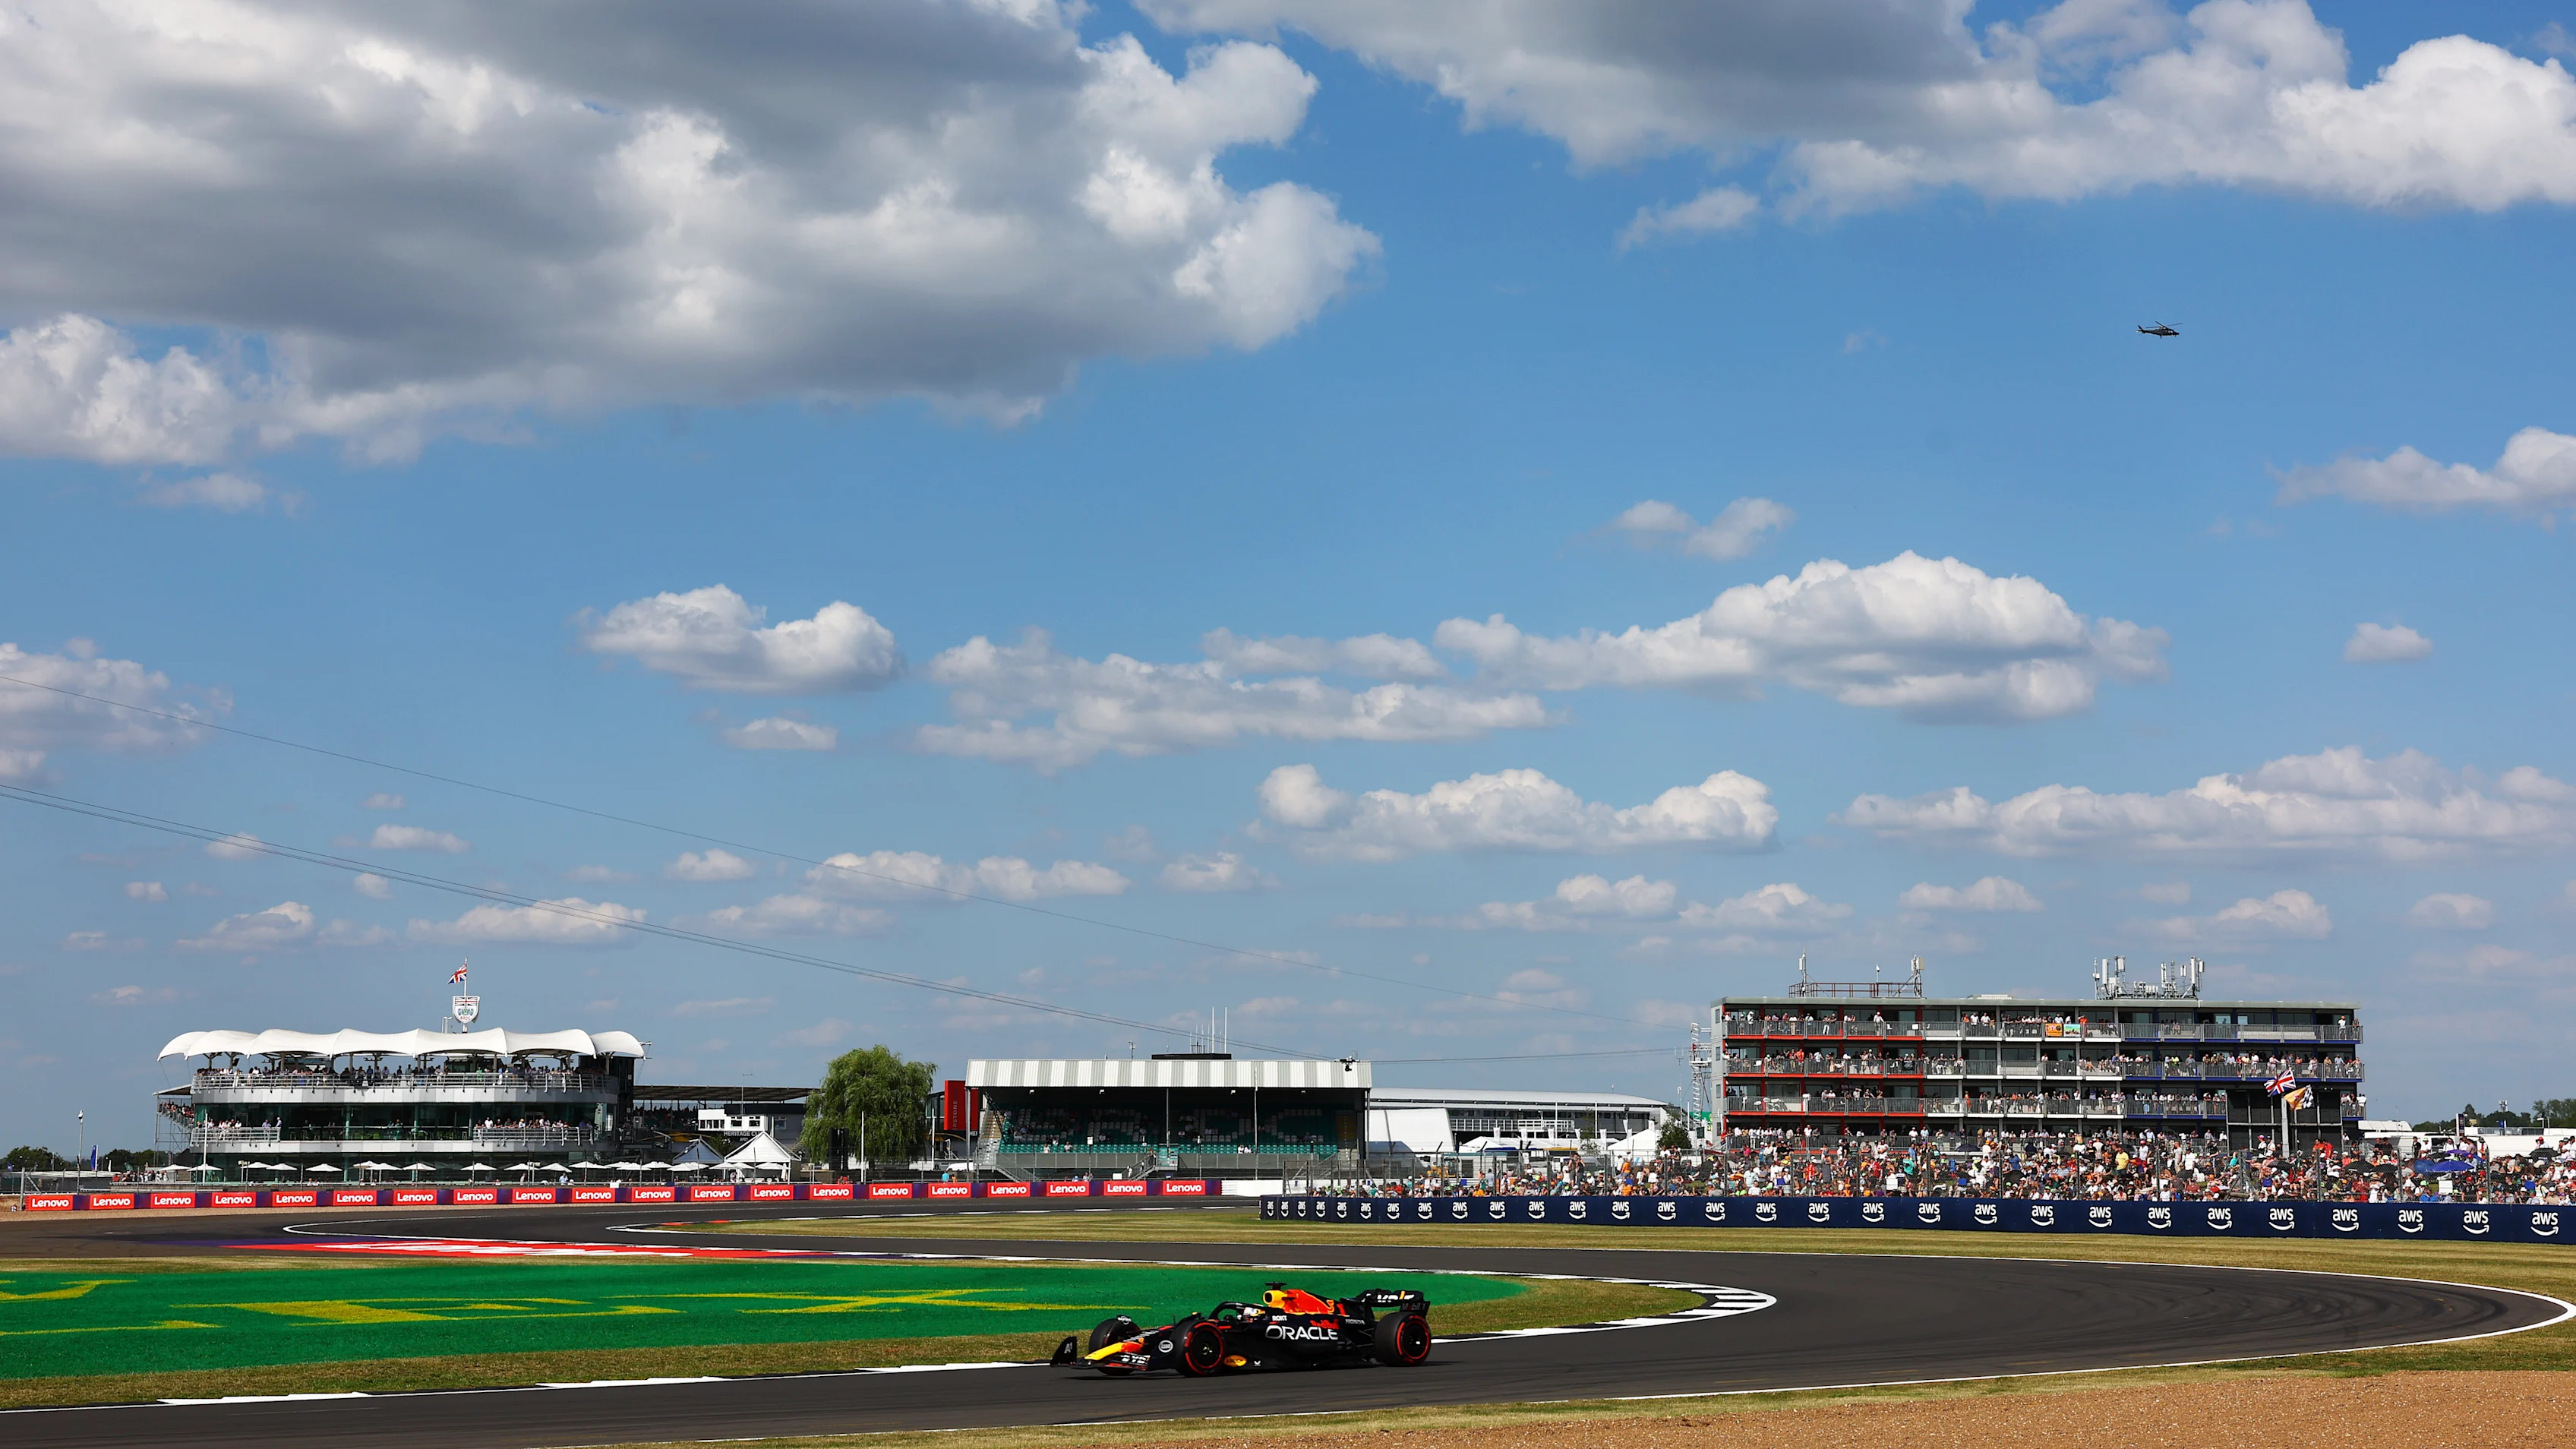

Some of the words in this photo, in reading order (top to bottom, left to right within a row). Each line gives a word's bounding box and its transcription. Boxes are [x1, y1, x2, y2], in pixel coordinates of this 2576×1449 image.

[754, 1189, 790, 1197] Lenovo
[814, 1188, 849, 1196] Lenovo
[873, 1187, 908, 1195] Lenovo
[932, 1186, 968, 1195] Lenovo
[991, 1185, 1027, 1194] Lenovo
[1050, 1185, 1086, 1193] Lenovo
[1107, 1184, 1143, 1192] Lenovo
[337, 1194, 373, 1202] Lenovo
[397, 1193, 433, 1201] Lenovo
[457, 1192, 493, 1201] Lenovo
[516, 1192, 552, 1200] Lenovo
[695, 1189, 731, 1198] Lenovo
[93, 1198, 131, 1206] Lenovo
[216, 1195, 252, 1204] Lenovo
[276, 1195, 313, 1203] Lenovo
[1337, 1202, 1346, 1211] aws
[1361, 1203, 1371, 1211] aws
[1387, 1203, 1399, 1212] aws
[1419, 1202, 1432, 1212] aws
[1453, 1202, 1467, 1211] aws
[1490, 1201, 1504, 1211] aws
[1529, 1201, 1545, 1211] aws
[1570, 1201, 1586, 1211] aws
[1612, 1201, 1629, 1211] aws
[1658, 1202, 1675, 1212] aws
[1706, 1202, 1725, 1213] aws
[1756, 1203, 1776, 1213] aws
[1809, 1203, 1829, 1214] aws
[1863, 1203, 1883, 1214] aws
[1918, 1204, 1940, 1214] aws
[1975, 1204, 1996, 1215] aws
[2031, 1205, 2053, 1217] aws
[2089, 1207, 2111, 1218] aws
[2148, 1208, 2170, 1219] aws
[2208, 1208, 2230, 1220] aws
[2270, 1208, 2293, 1220] aws
[2333, 1209, 2357, 1221] aws
[2398, 1210, 2423, 1223] aws
[2464, 1211, 2488, 1223] aws
[2532, 1212, 2558, 1225] aws
[1400, 1302, 1420, 1311] Mobil
[1265, 1324, 1339, 1340] ORACLE
